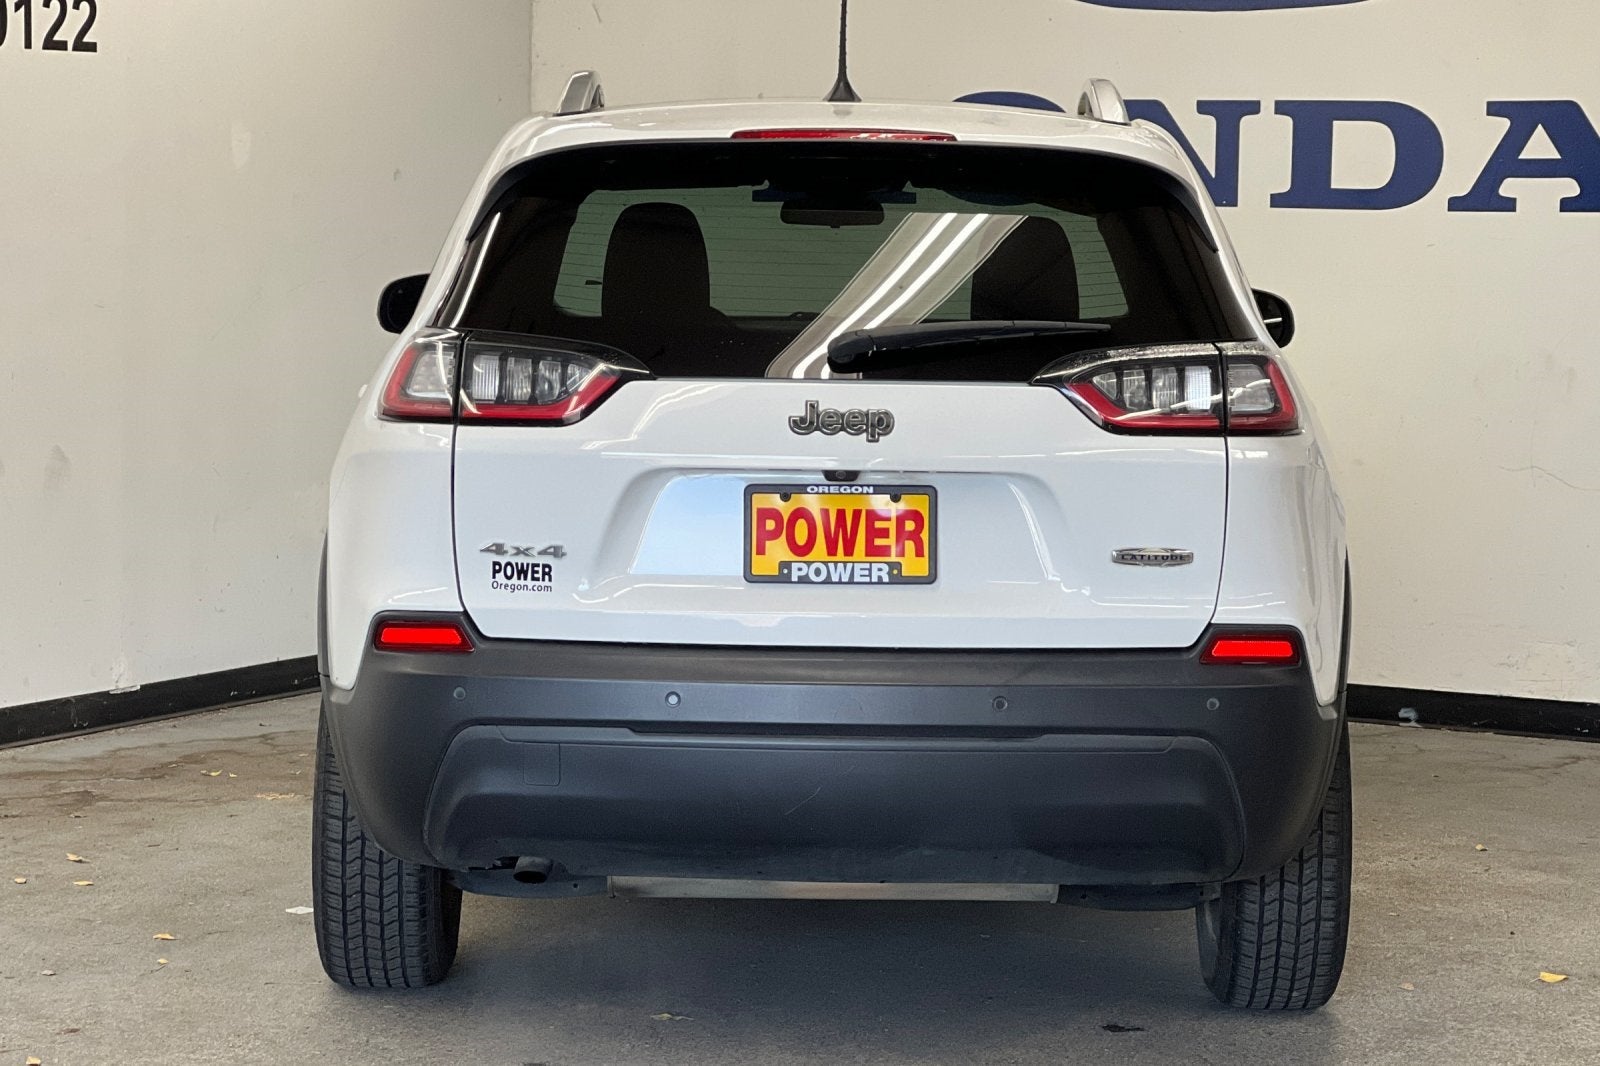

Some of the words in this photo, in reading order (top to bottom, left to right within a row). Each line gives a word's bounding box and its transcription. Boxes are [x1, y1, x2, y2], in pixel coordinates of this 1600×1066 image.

[953, 90, 1600, 213] NDA
[788, 399, 895, 443] Jeep
[806, 485, 874, 494] OREGON
[755, 506, 925, 558] POWER
[491, 560, 553, 582] POWER
[791, 562, 889, 582] POWER
[491, 580, 553, 593] Oregon.com
